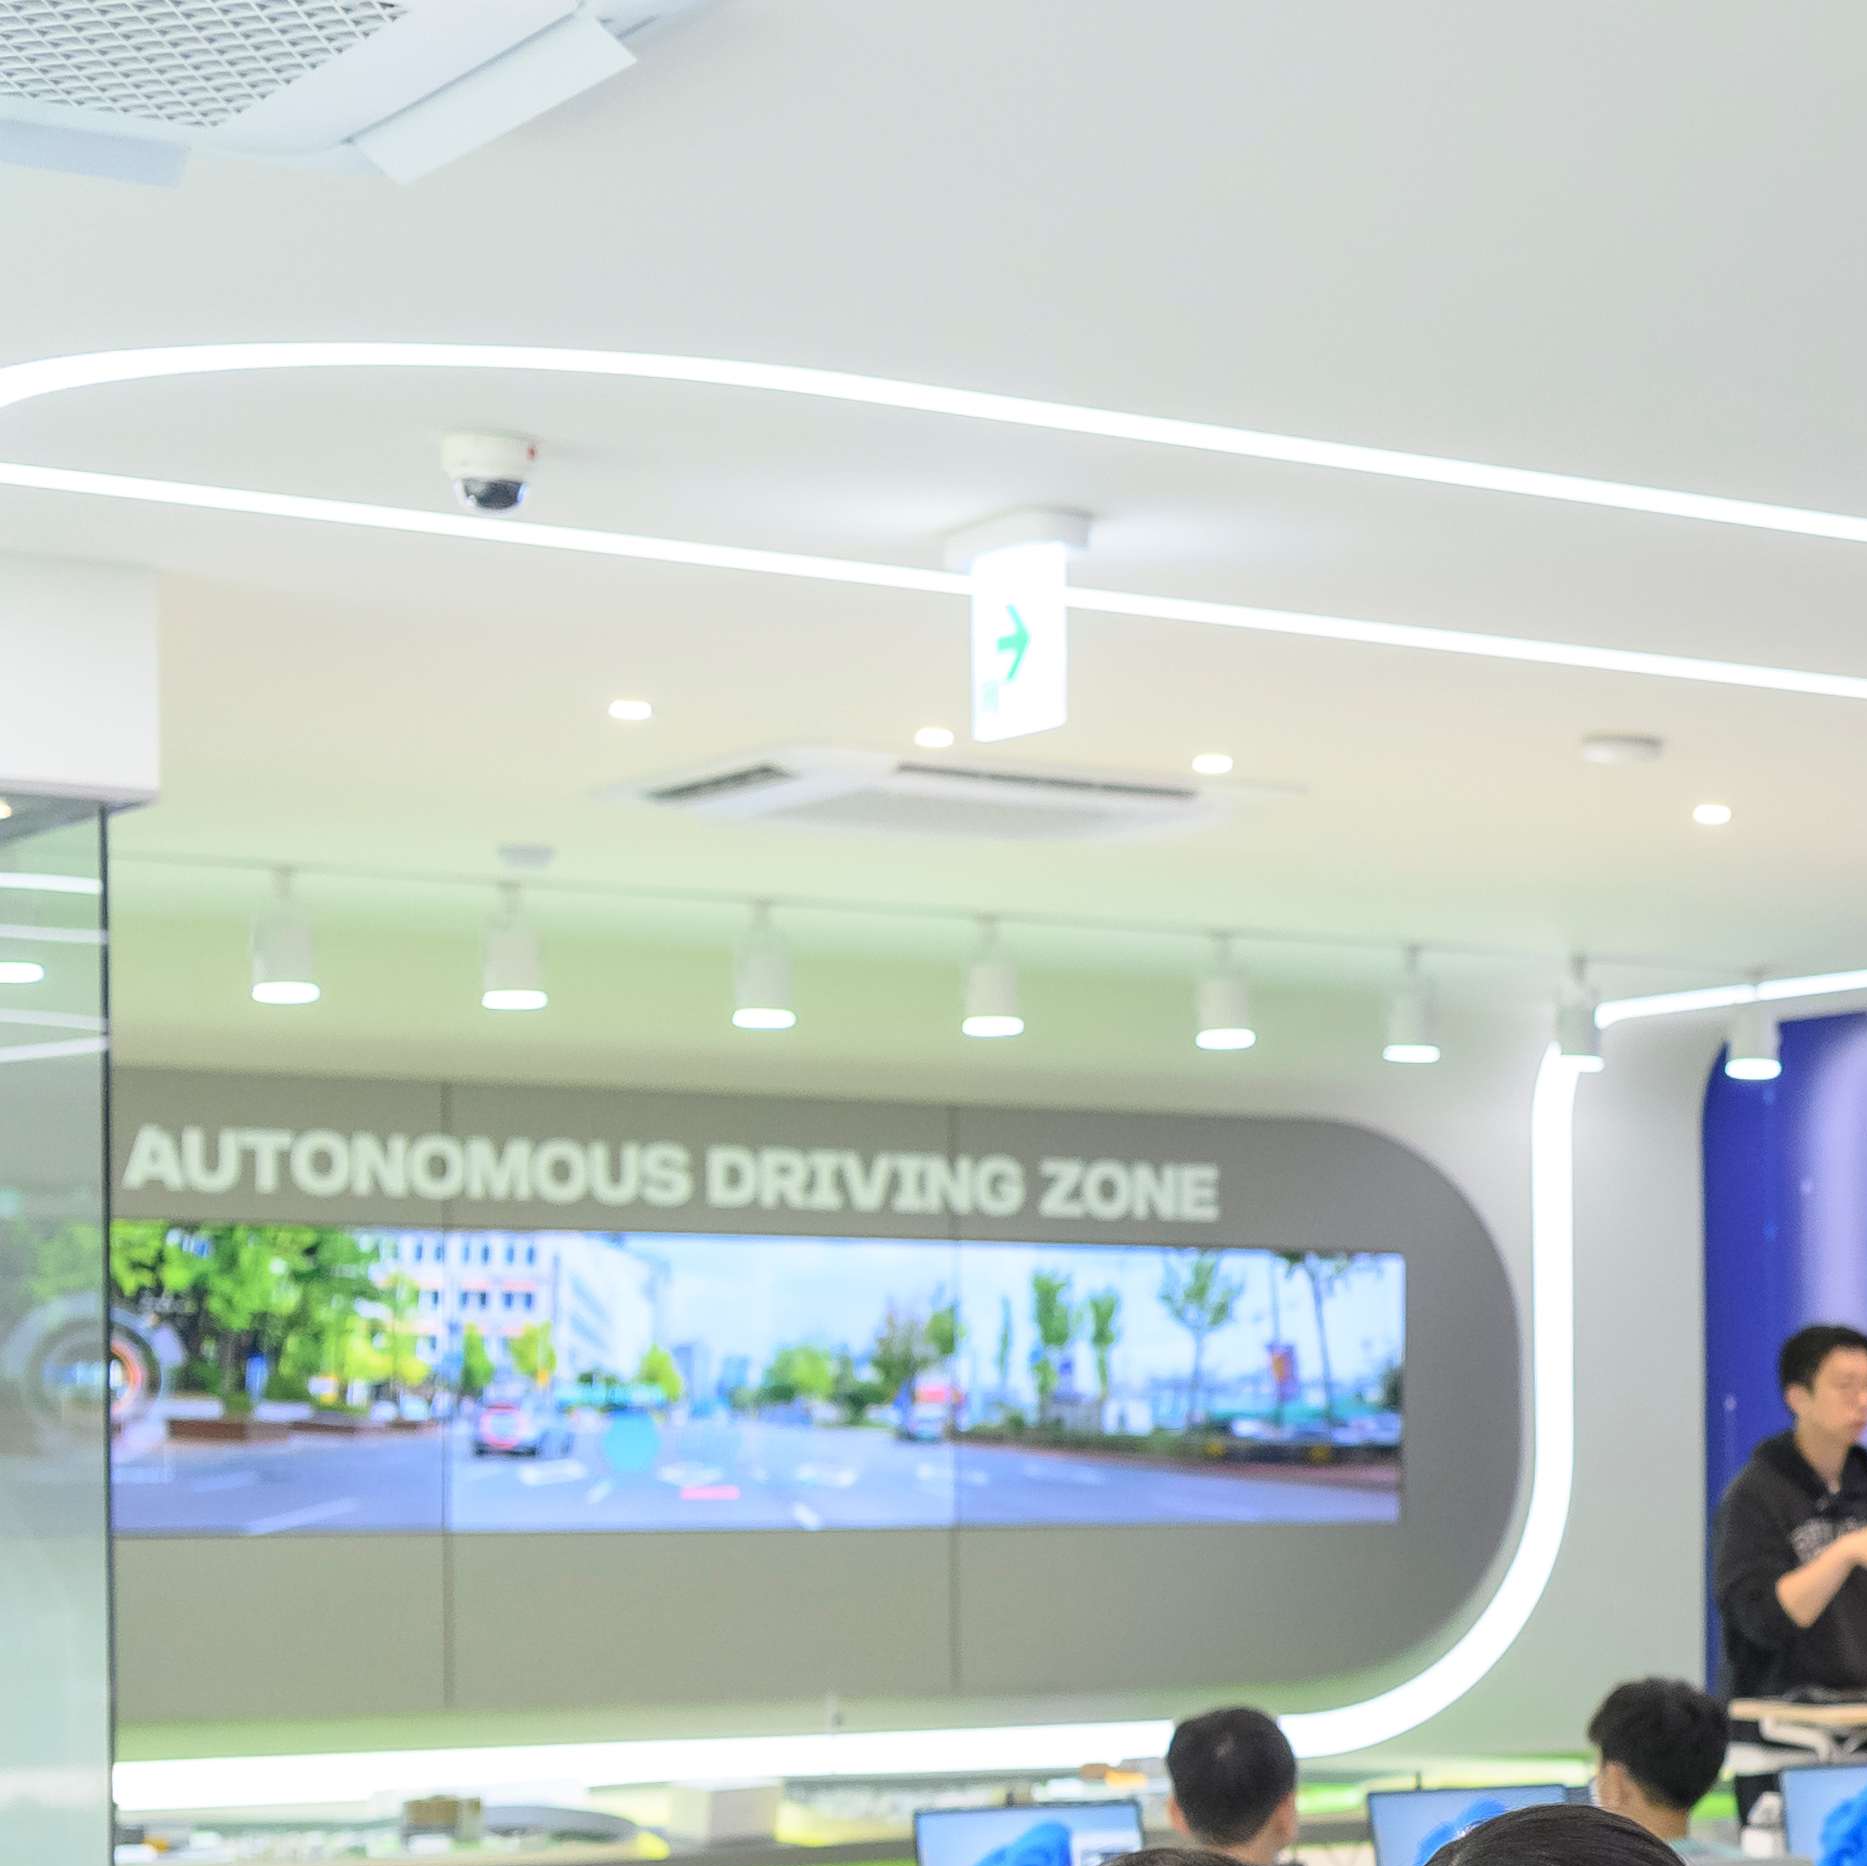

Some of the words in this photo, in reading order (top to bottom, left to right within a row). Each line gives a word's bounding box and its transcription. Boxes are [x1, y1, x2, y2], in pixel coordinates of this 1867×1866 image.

[122, 1124, 695, 1208] AUTONOMOUS
[705, 1145, 1026, 1217] DRIVING
[1038, 1156, 1221, 1223] ZONE
